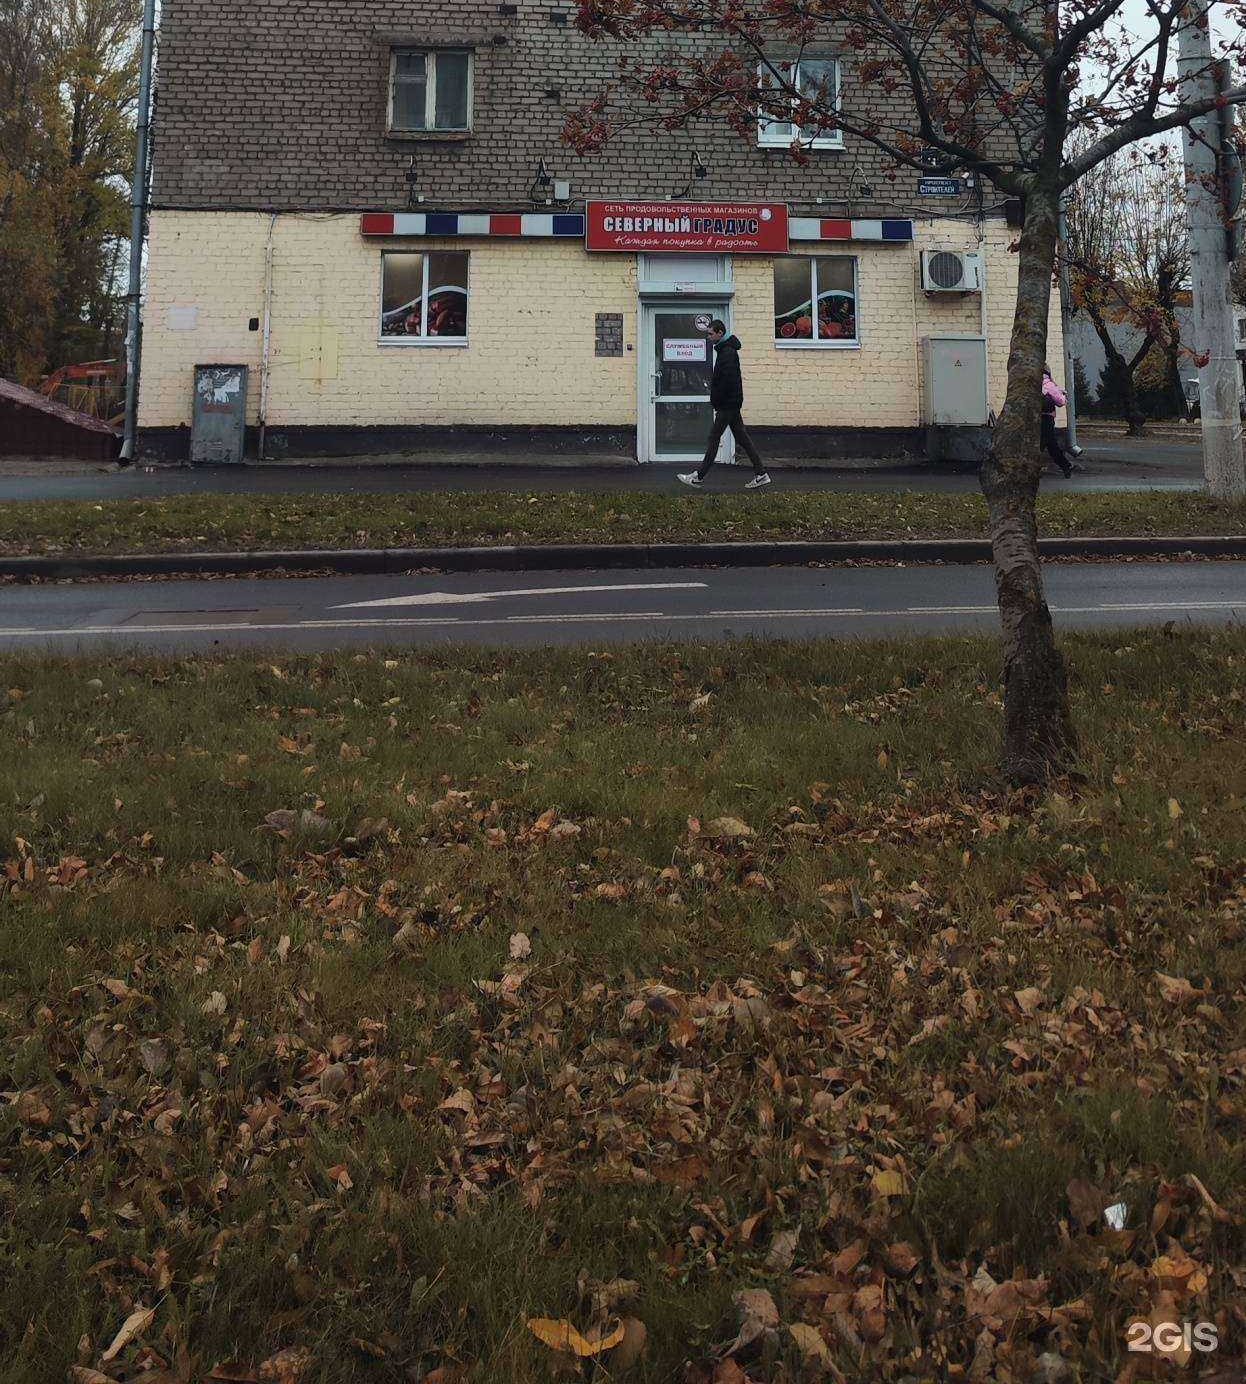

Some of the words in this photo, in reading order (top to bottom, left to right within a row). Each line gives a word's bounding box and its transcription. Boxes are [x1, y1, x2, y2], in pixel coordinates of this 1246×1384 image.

[626, 205, 712, 214] ПРОДОВОЛЬСТВЕННЫХ
[603, 215, 691, 233] СЕВЕРНЫЙ
[693, 217, 759, 236] ГРАДУС
[614, 235, 660, 246] Каждая
[662, 239, 704, 248] покупка
[706, 236, 713, 246] в
[715, 239, 758, 248] радость
